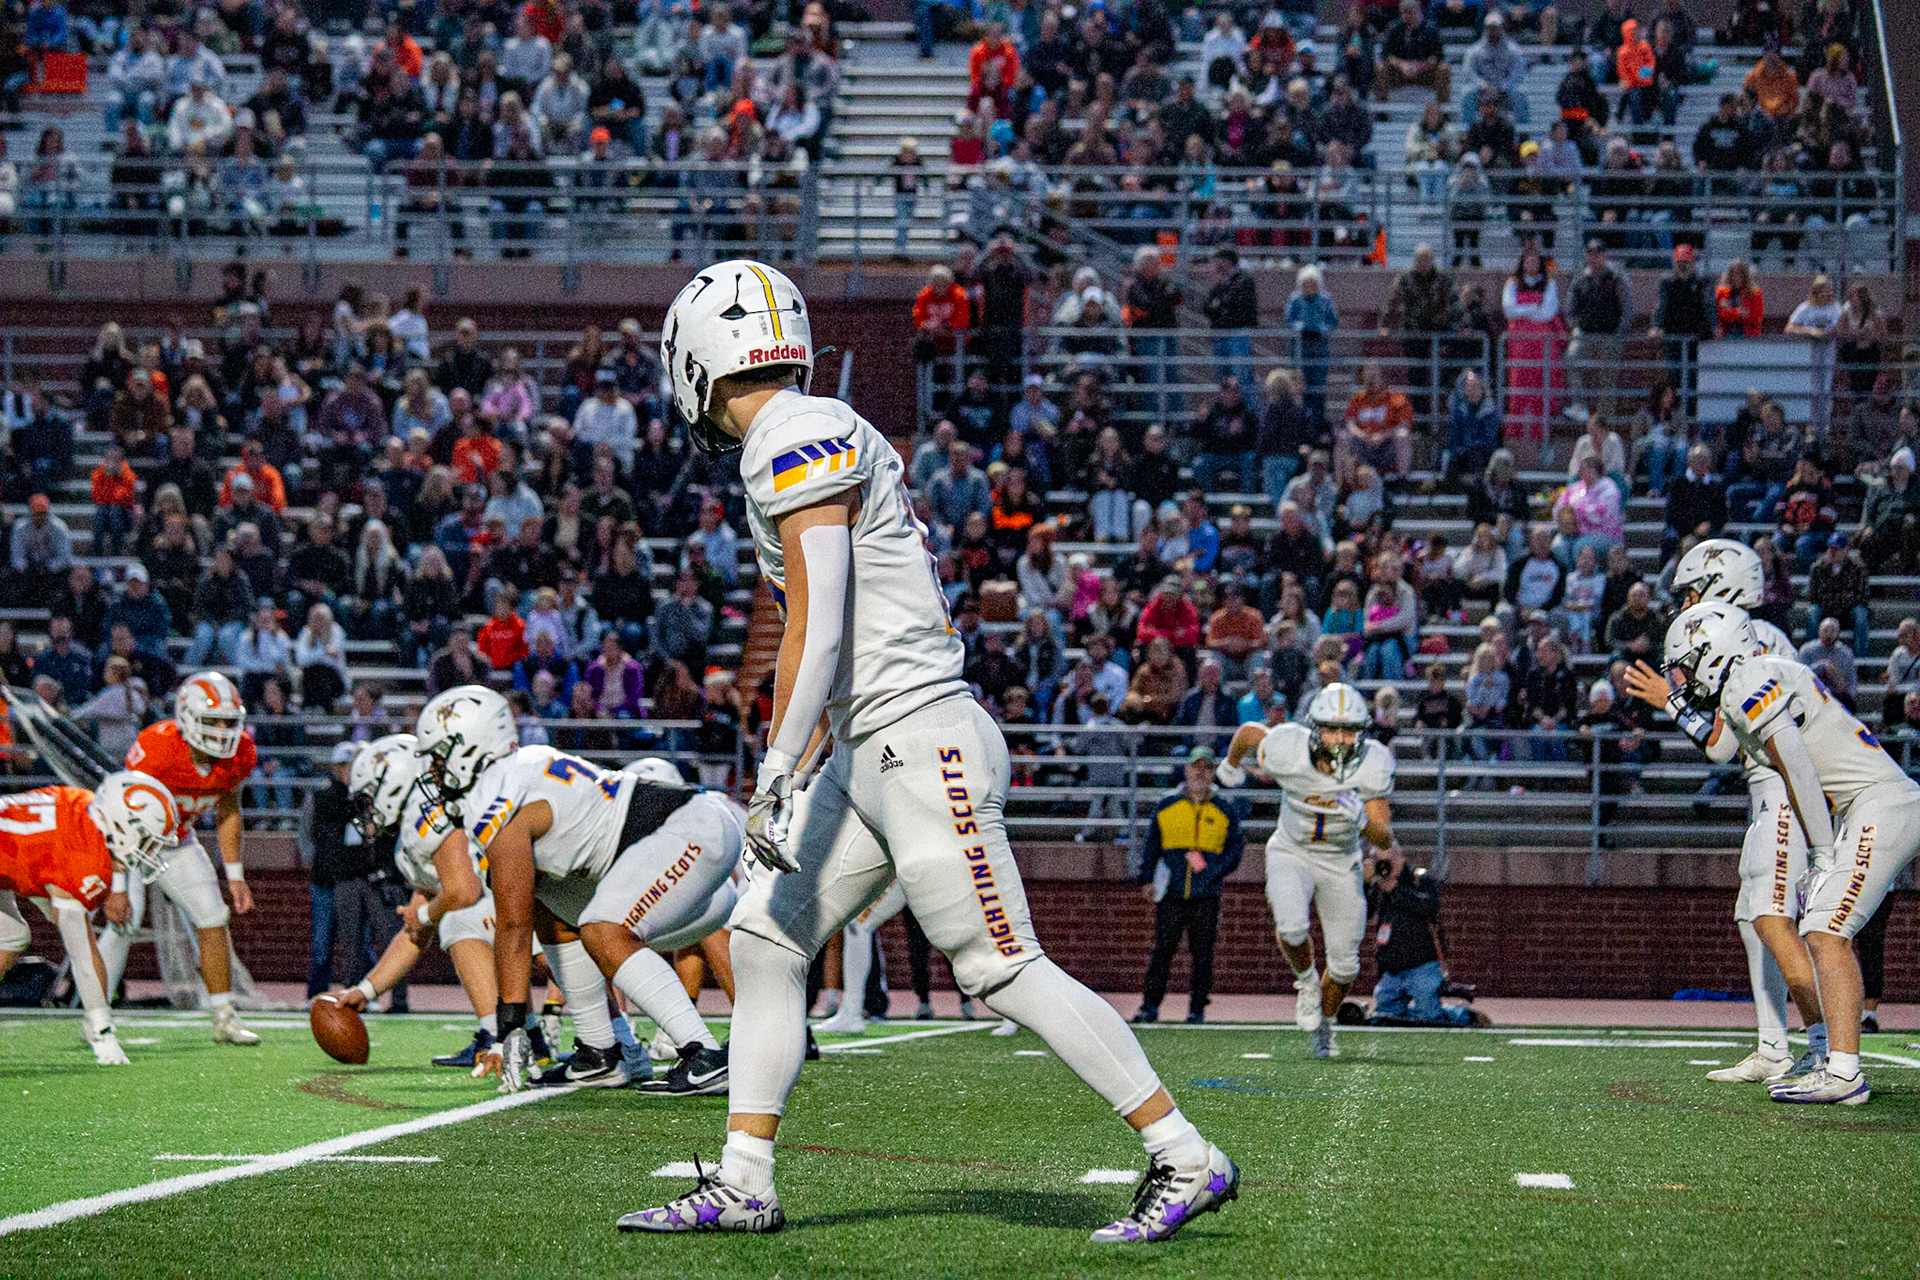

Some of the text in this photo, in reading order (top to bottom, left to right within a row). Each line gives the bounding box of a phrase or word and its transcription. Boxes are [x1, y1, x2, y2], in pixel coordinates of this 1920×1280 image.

[749, 345, 806, 364] Riddell
[623, 840, 702, 928] IGHTING SCOTS
[938, 747, 1025, 958] FIGHTING SCOTS
[1828, 869, 1866, 933] FIGHTING
